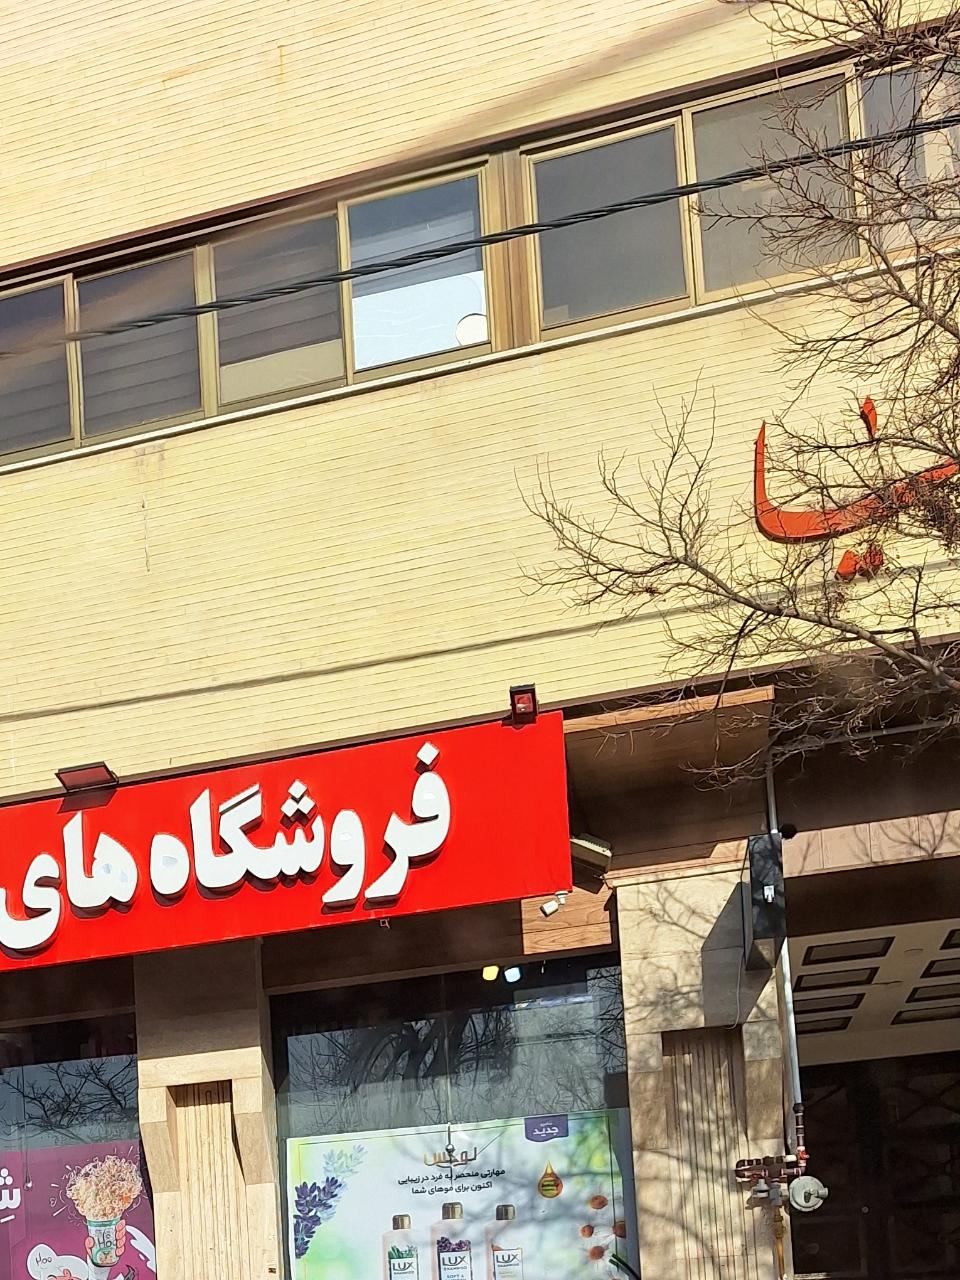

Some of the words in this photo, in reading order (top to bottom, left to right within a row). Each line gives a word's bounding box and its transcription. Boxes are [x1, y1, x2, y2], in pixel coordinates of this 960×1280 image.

[150, 741, 451, 903] فروشگاه
[532, 1126, 559, 1137] جدید
[431, 1173, 443, 1183] فرد
[454, 1172, 480, 1181] منحصر
[480, 1168, 506, 1179] مهارتی
[421, 1176, 430, 1184] در
[411, 1186, 427, 1195] شما
[427, 1186, 454, 1196] موهای
[454, 1183, 470, 1193] برای
[470, 1181, 493, 1192] اکنون
[442, 1255, 468, 1267] LUX
[496, 1253, 521, 1264] LUX
[393, 1261, 415, 1272] LUX
